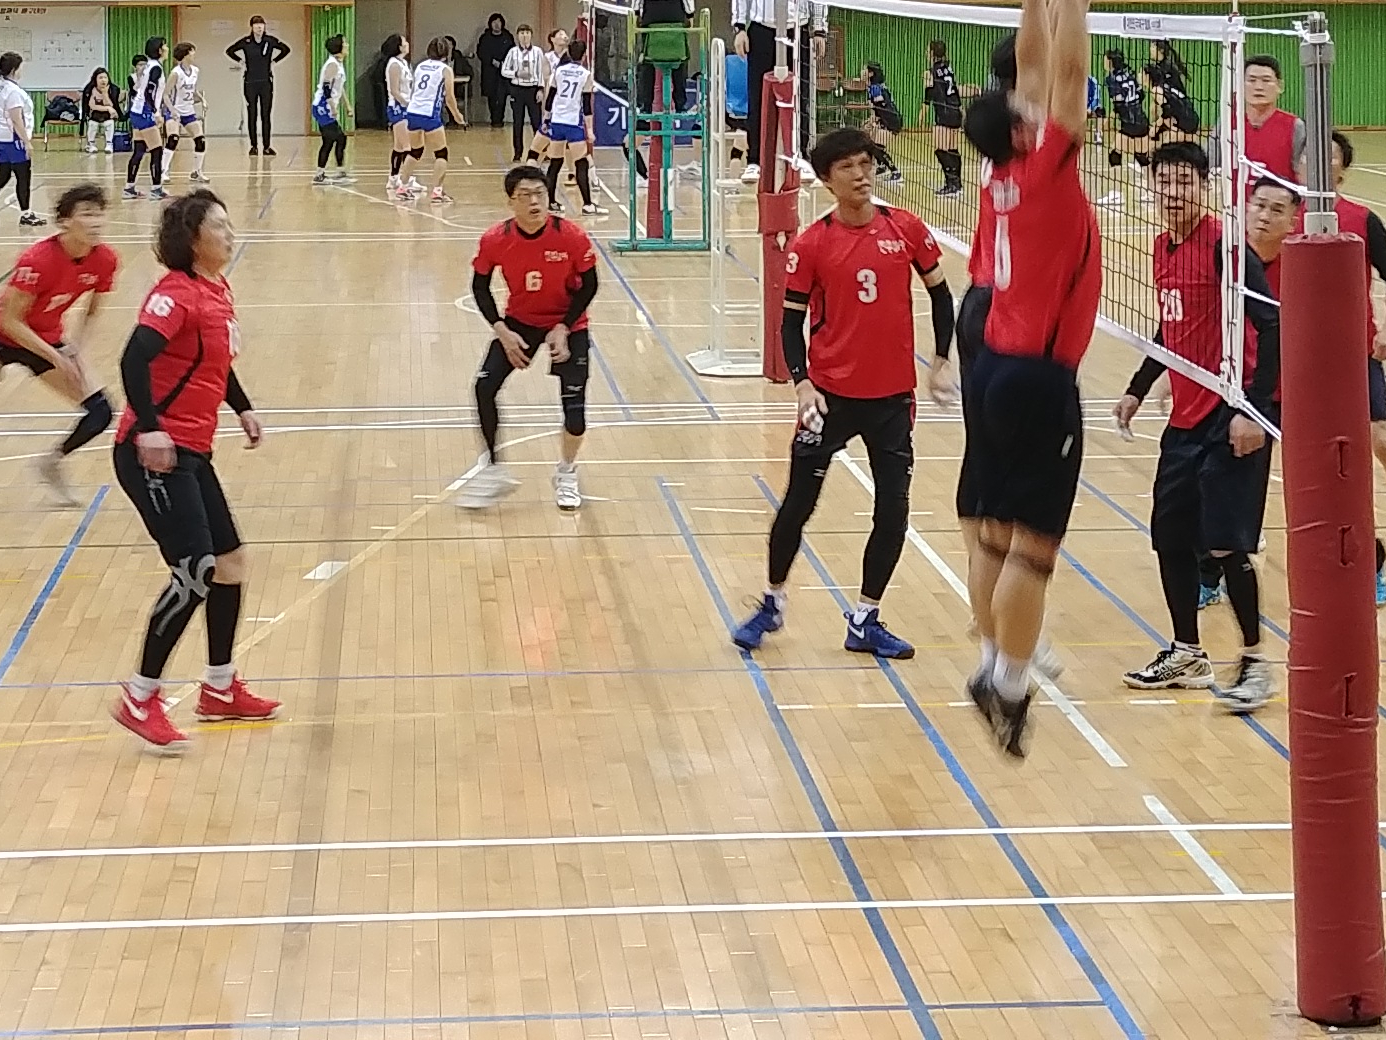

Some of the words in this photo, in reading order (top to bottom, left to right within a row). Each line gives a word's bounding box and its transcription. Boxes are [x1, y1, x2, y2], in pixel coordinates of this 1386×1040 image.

[417, 74, 431, 90] 8
[560, 79, 579, 99] 21
[785, 252, 799, 274] 3
[525, 270, 543, 292] 6
[856, 268, 878, 304] 3
